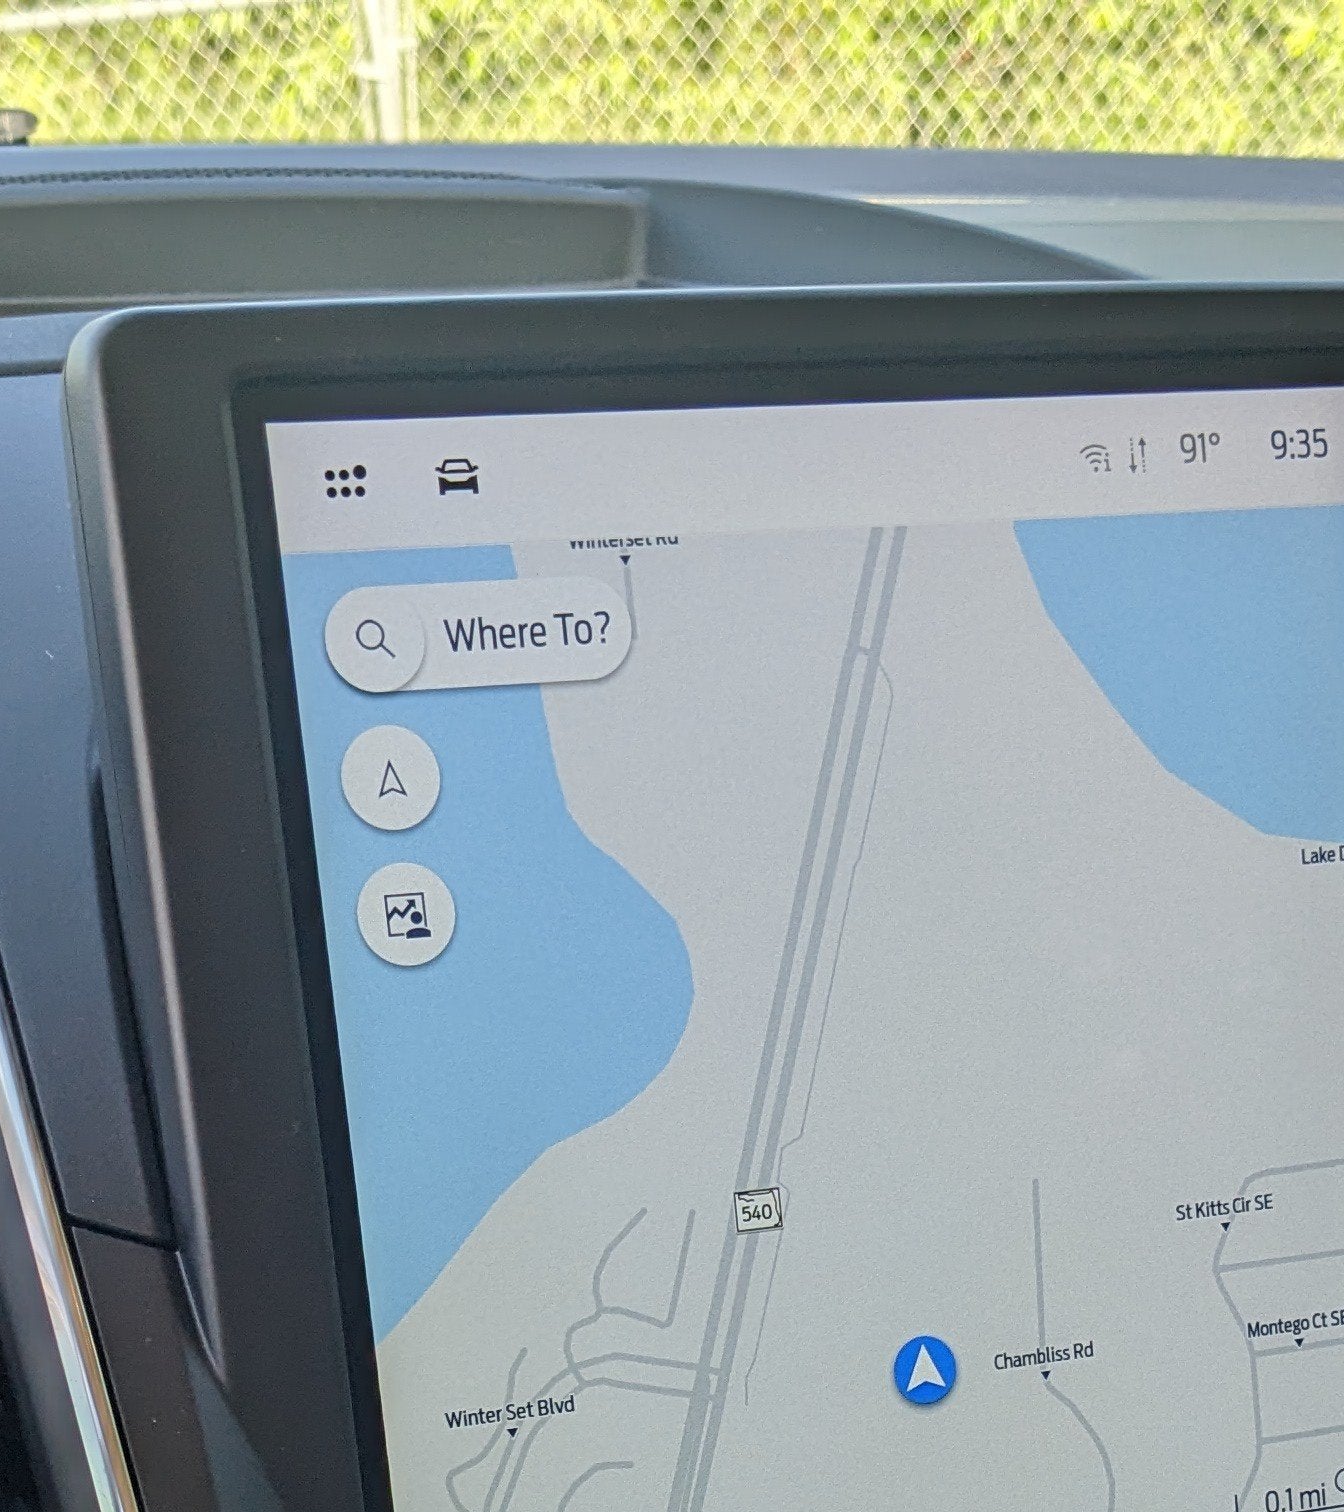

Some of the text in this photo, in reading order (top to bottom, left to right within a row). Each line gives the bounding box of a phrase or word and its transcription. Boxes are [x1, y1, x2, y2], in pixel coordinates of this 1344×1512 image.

[1179, 432, 1221, 464] 91°
[1270, 428, 1328, 460] 9:35
[443, 610, 610, 653] Where To?
[1301, 846, 1336, 865] Lake
[741, 1203, 773, 1223] 540
[1175, 1192, 1274, 1221] St Kitts Cir SE
[1247, 1317, 1311, 1338] Montego
[1312, 1312, 1328, 1330] Ct
[993, 1340, 1095, 1370] Chambliss Rd
[444, 1395, 577, 1429] Winter Set Blvd
[1299, 1482, 1327, 1509] mi
